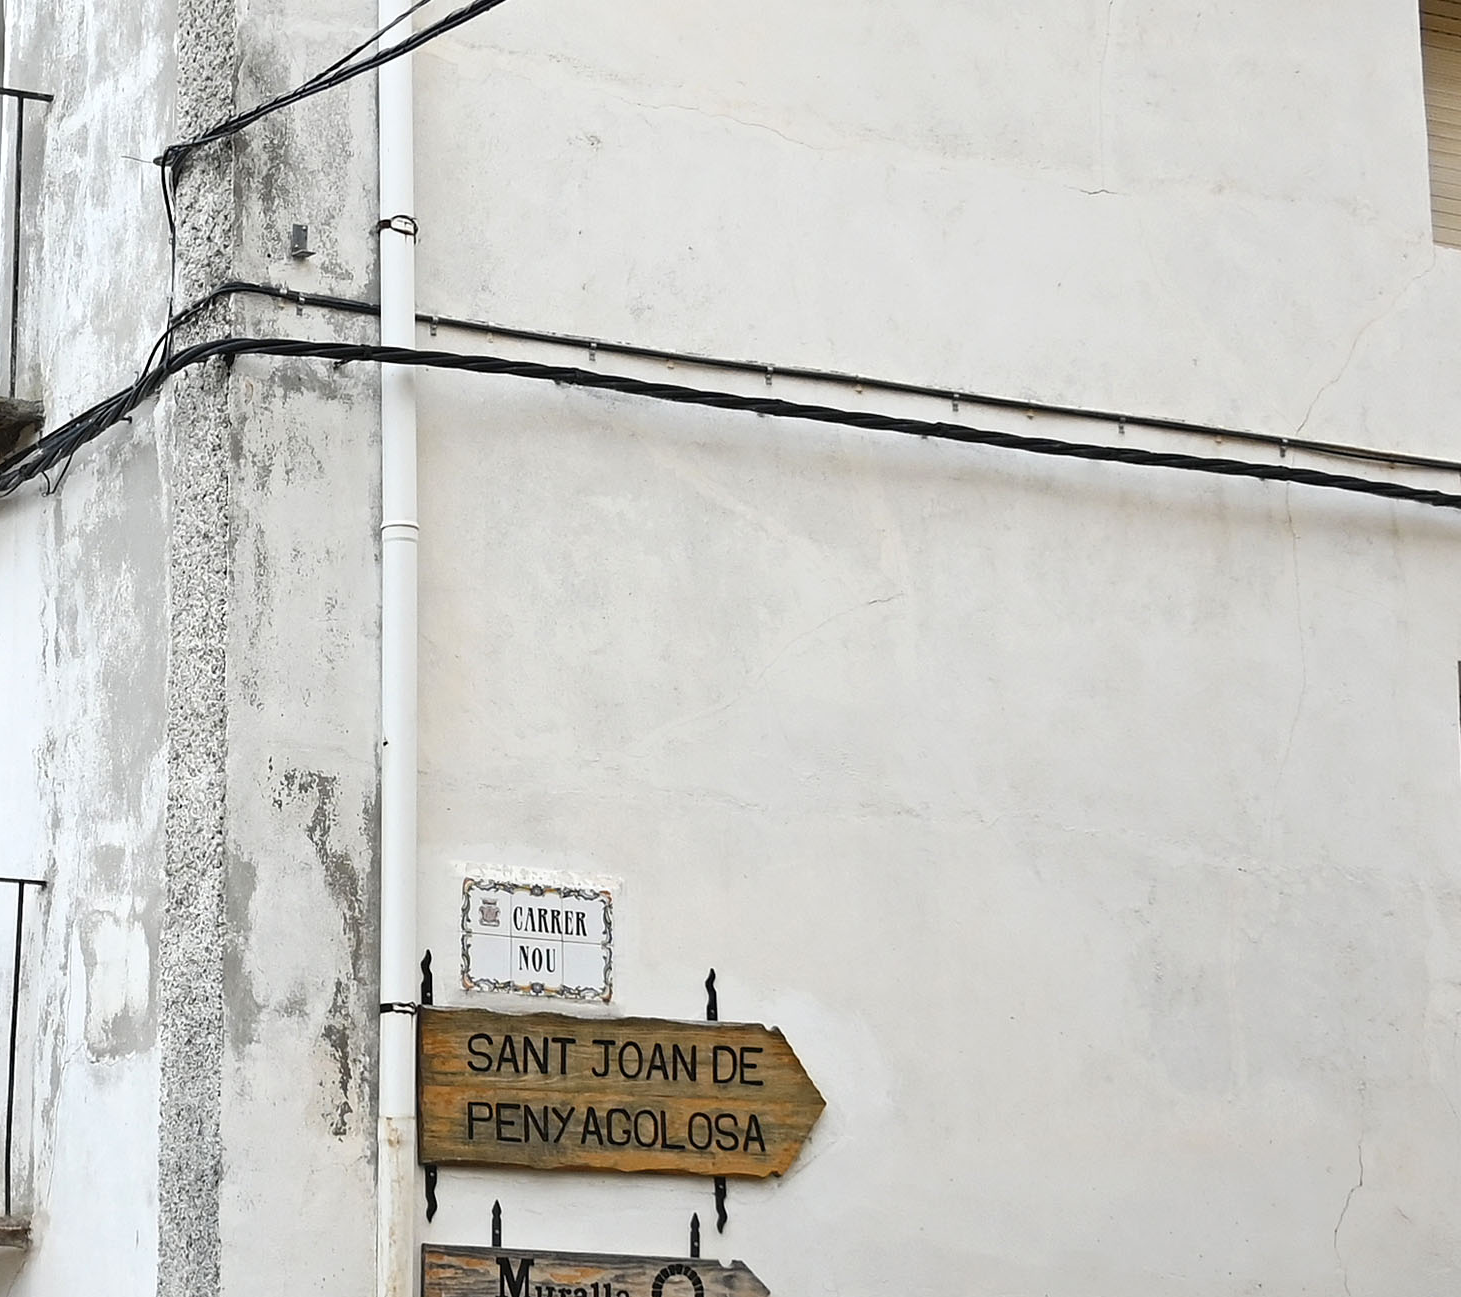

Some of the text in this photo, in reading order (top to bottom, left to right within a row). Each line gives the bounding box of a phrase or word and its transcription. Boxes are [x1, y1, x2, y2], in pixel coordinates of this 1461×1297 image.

[513, 906, 587, 937] CARRER
[519, 945, 556, 973] NOU
[467, 1033, 764, 1086] SANT JOAN DE
[467, 1101, 767, 1152] PENYAGOLOSA
